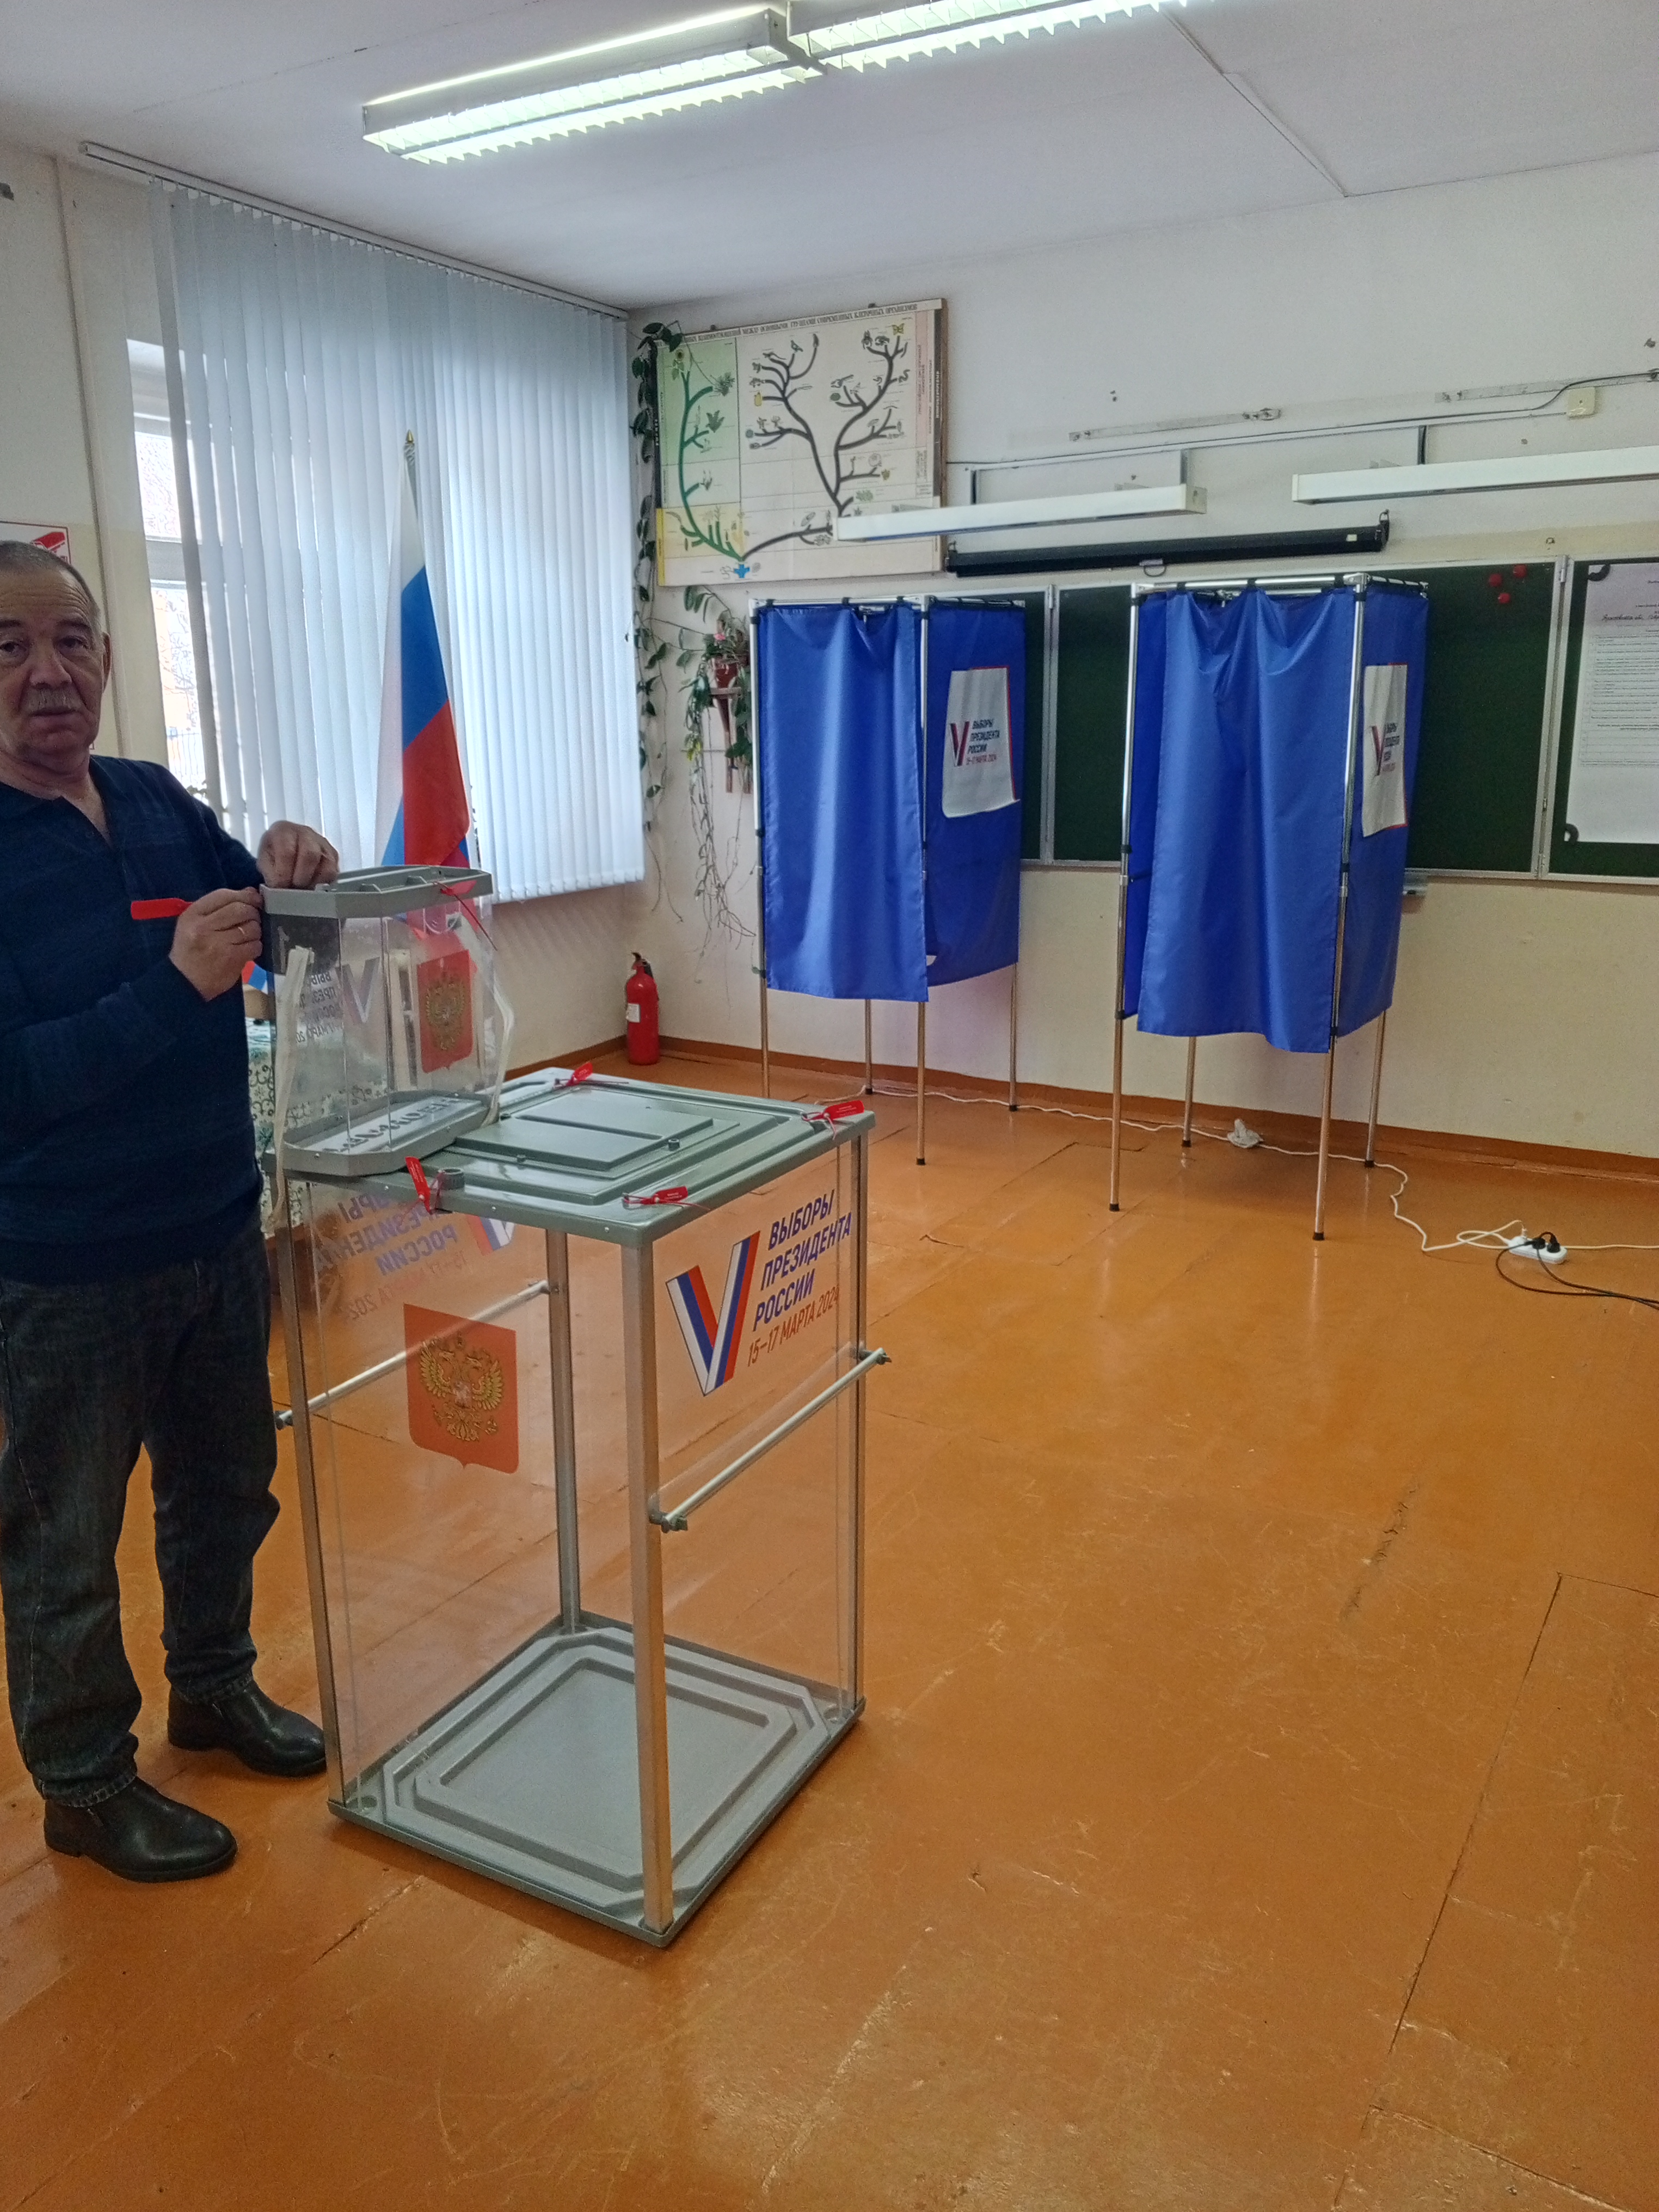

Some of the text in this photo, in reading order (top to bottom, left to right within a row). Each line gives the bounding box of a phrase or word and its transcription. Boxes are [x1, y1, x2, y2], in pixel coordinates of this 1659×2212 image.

[760, 1212, 852, 1291] ПРЕЗИДЕНТА
[769, 1189, 835, 1251] ВЫБОРЫ
[753, 1268, 815, 1332] РОССИИ
[779, 1300, 816, 1345] МАРТА
[816, 1286, 840, 1318] 2024
